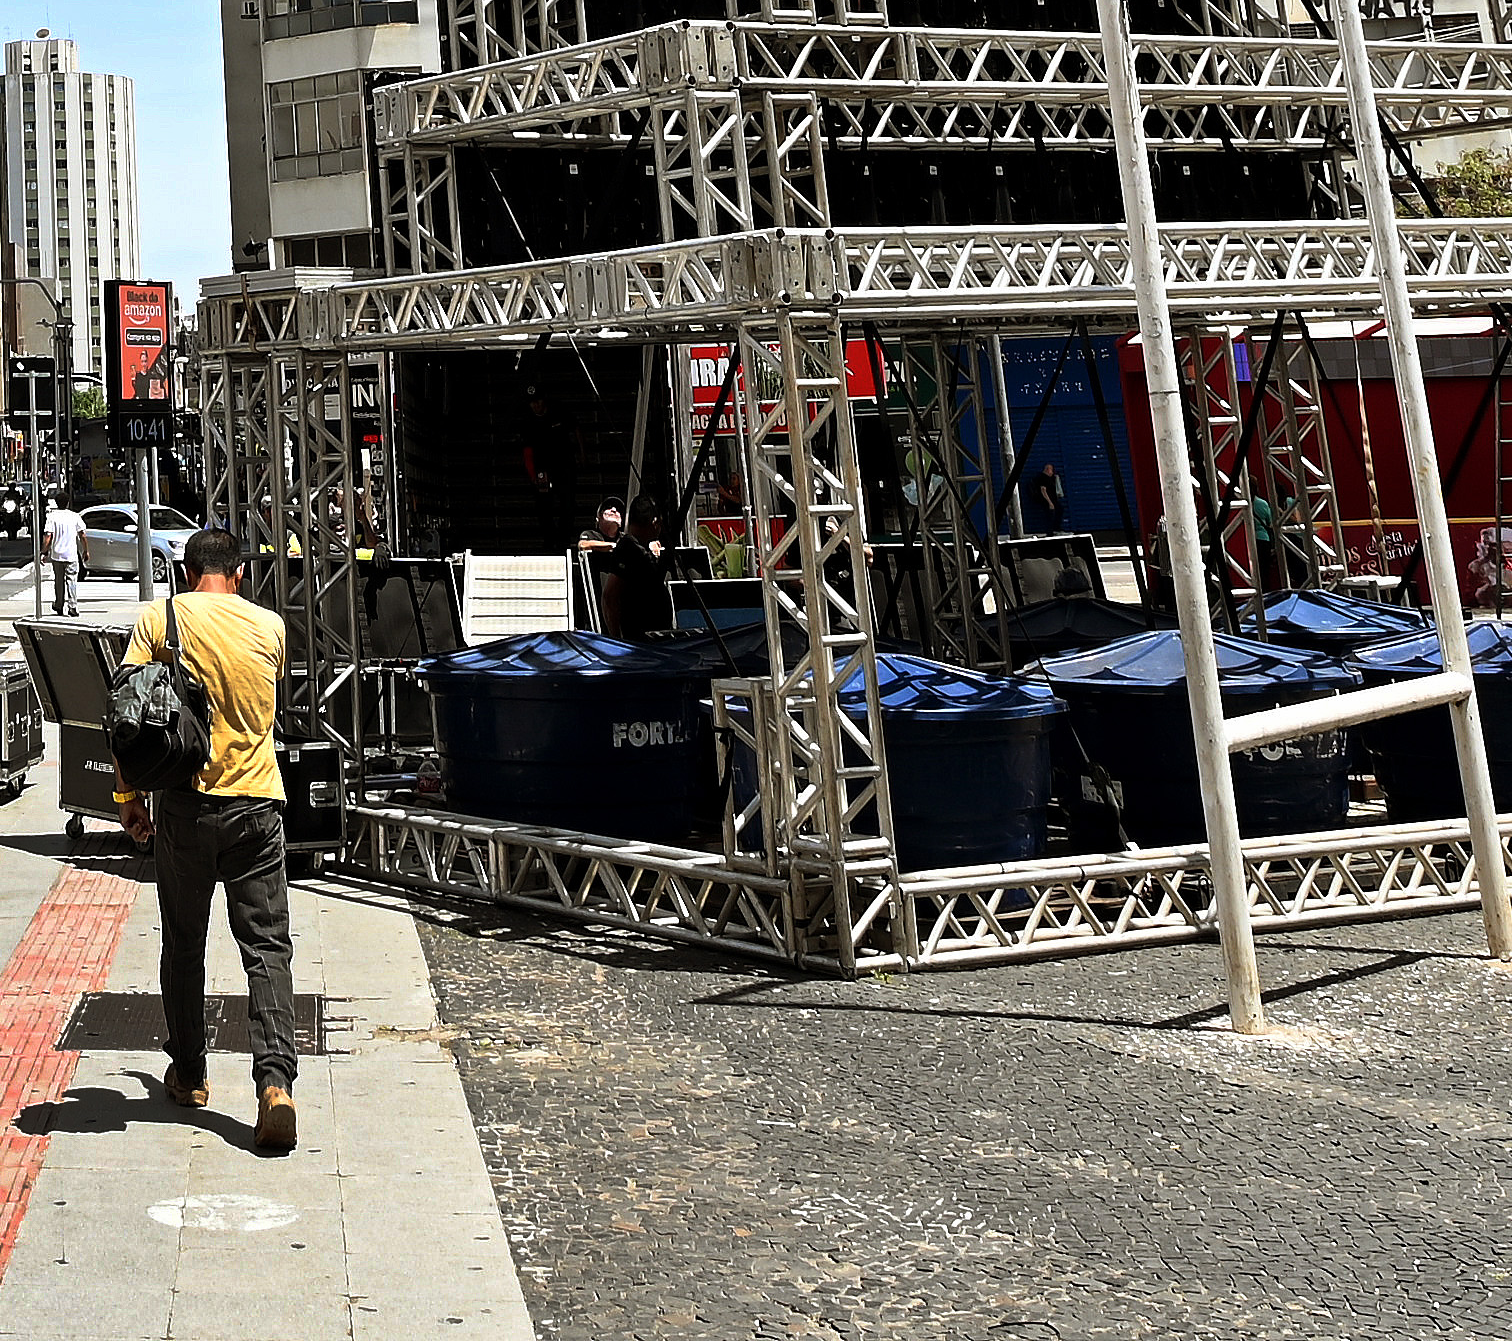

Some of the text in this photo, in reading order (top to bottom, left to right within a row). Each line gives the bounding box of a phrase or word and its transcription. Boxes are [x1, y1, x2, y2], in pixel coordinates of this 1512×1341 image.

[124, 304, 162, 318] amazon
[126, 418, 166, 442] 10:41
[613, 721, 690, 748] FORT
